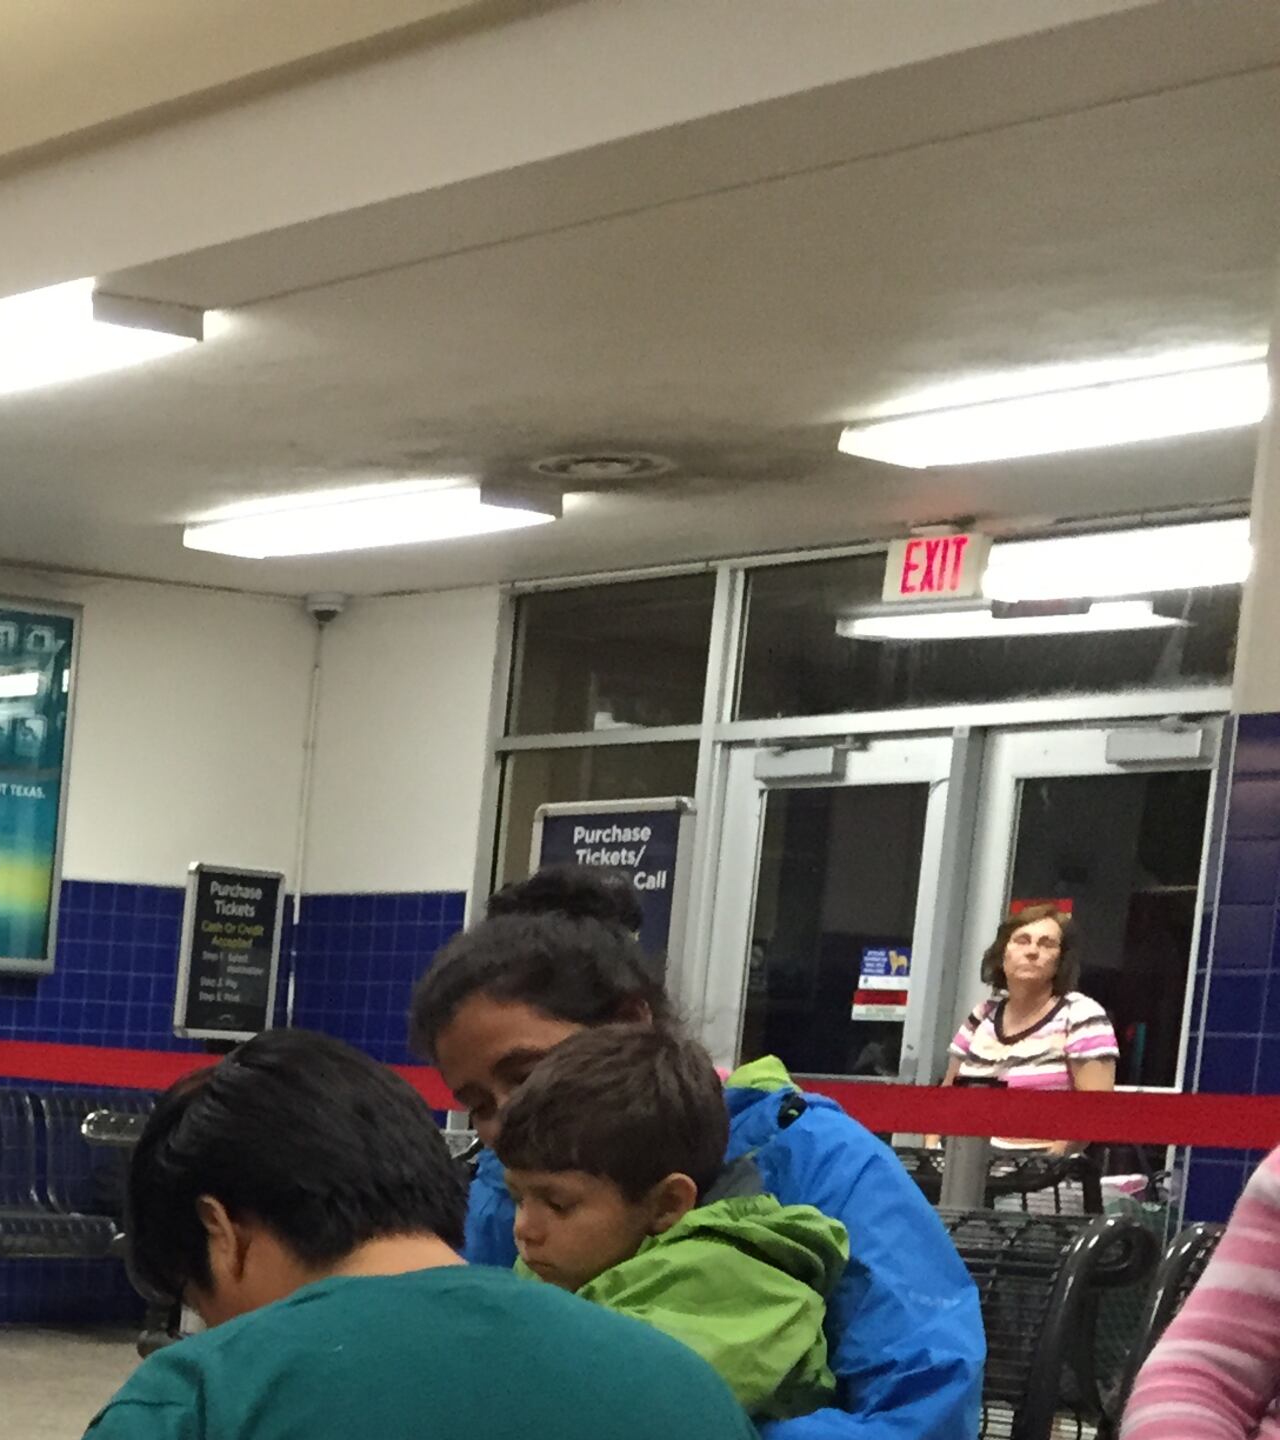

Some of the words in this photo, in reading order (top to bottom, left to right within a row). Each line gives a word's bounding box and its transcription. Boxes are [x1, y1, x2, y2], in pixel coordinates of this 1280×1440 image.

[901, 536, 968, 593] EXIT
[573, 824, 651, 844] Purchase
[576, 844, 646, 867] Tickets/
[634, 870, 667, 890] Call
[210, 881, 262, 900] Purchase
[214, 899, 255, 917] Tickets
